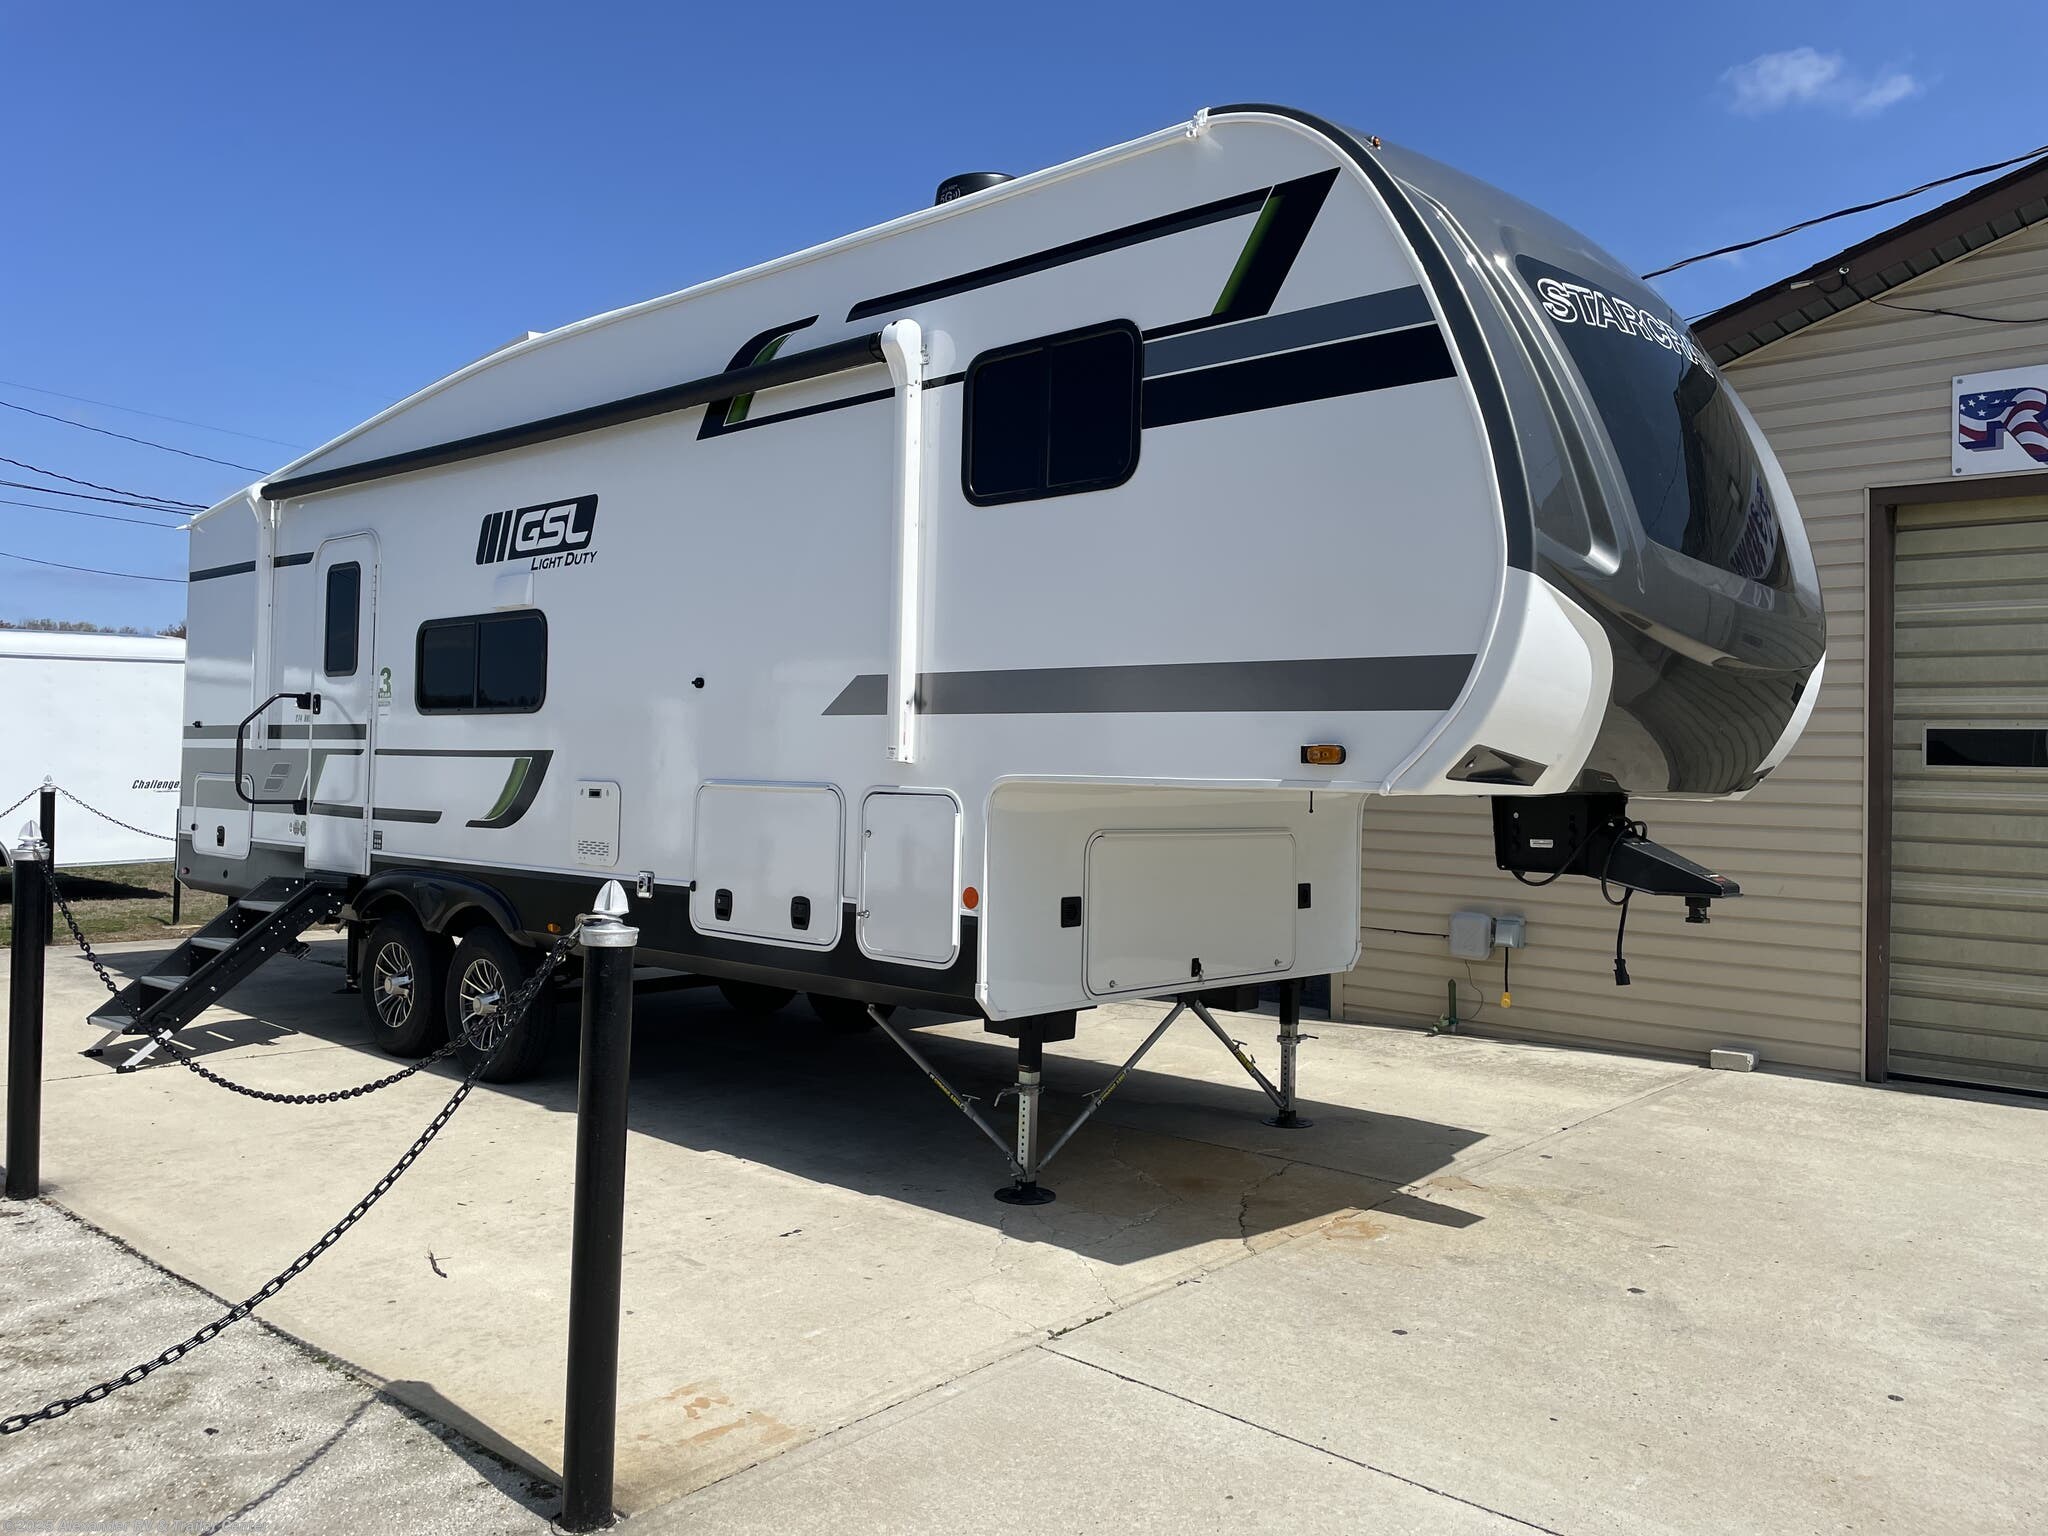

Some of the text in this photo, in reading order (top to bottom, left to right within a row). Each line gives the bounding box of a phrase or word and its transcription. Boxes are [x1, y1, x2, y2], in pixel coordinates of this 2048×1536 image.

[515, 503, 589, 552] GSL
[530, 551, 598, 571] LIGHT DUTY
[380, 667, 391, 692] 3
